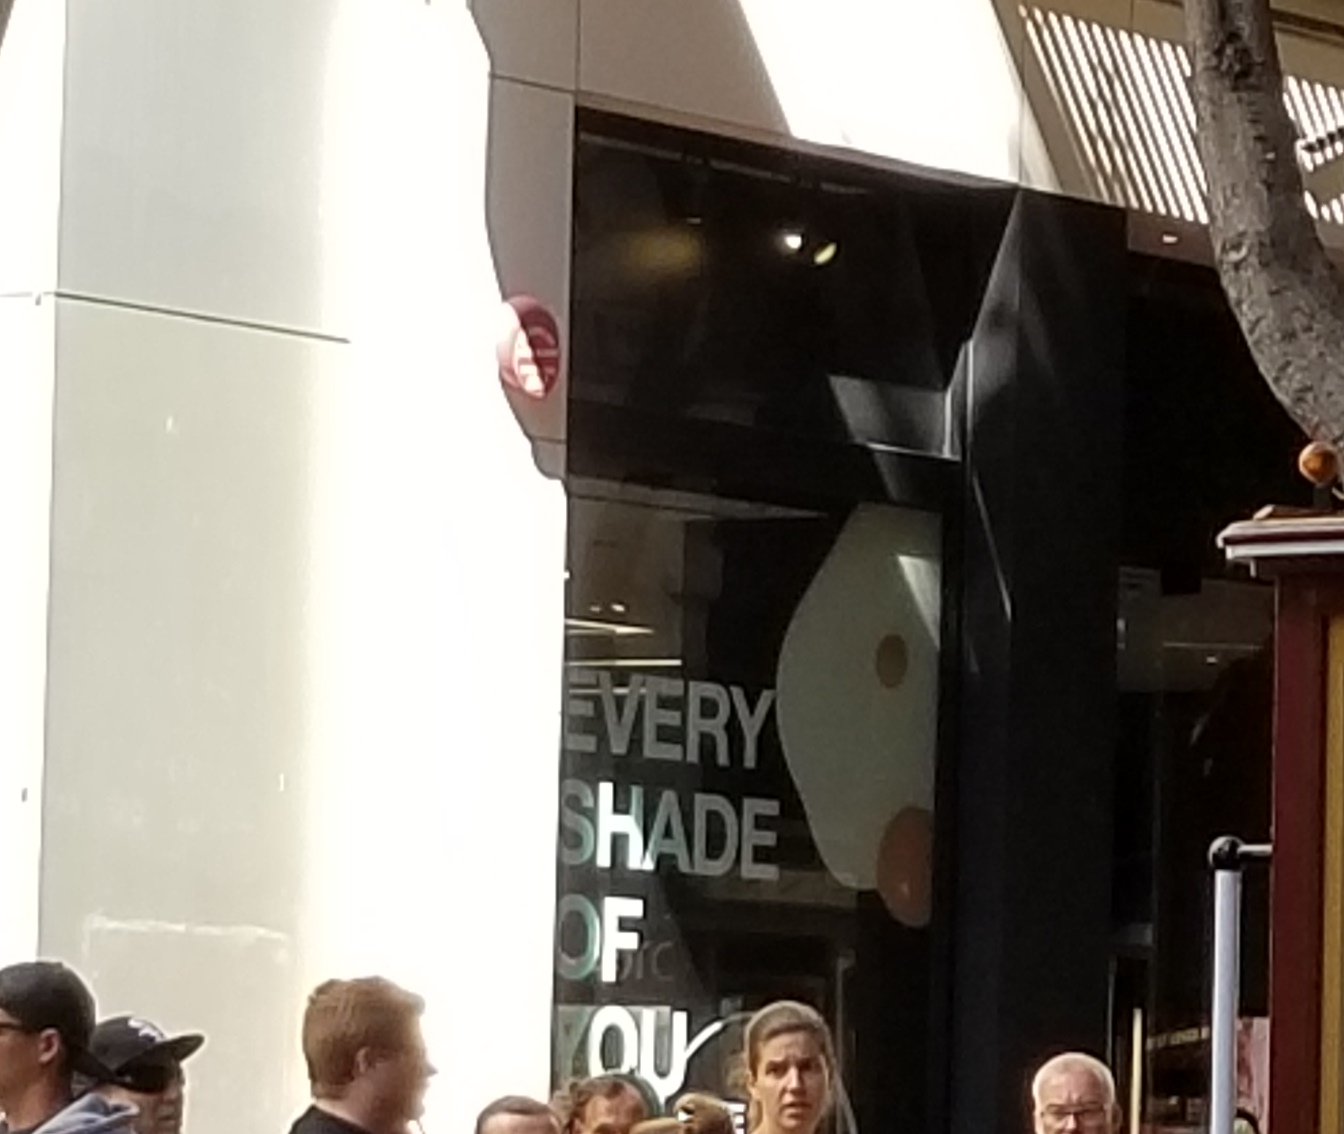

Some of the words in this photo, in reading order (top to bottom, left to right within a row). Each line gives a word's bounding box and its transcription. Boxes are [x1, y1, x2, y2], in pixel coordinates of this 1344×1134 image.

[563, 668, 776, 770] EVERY
[560, 779, 780, 881] SHADE
[556, 893, 644, 983] OF
